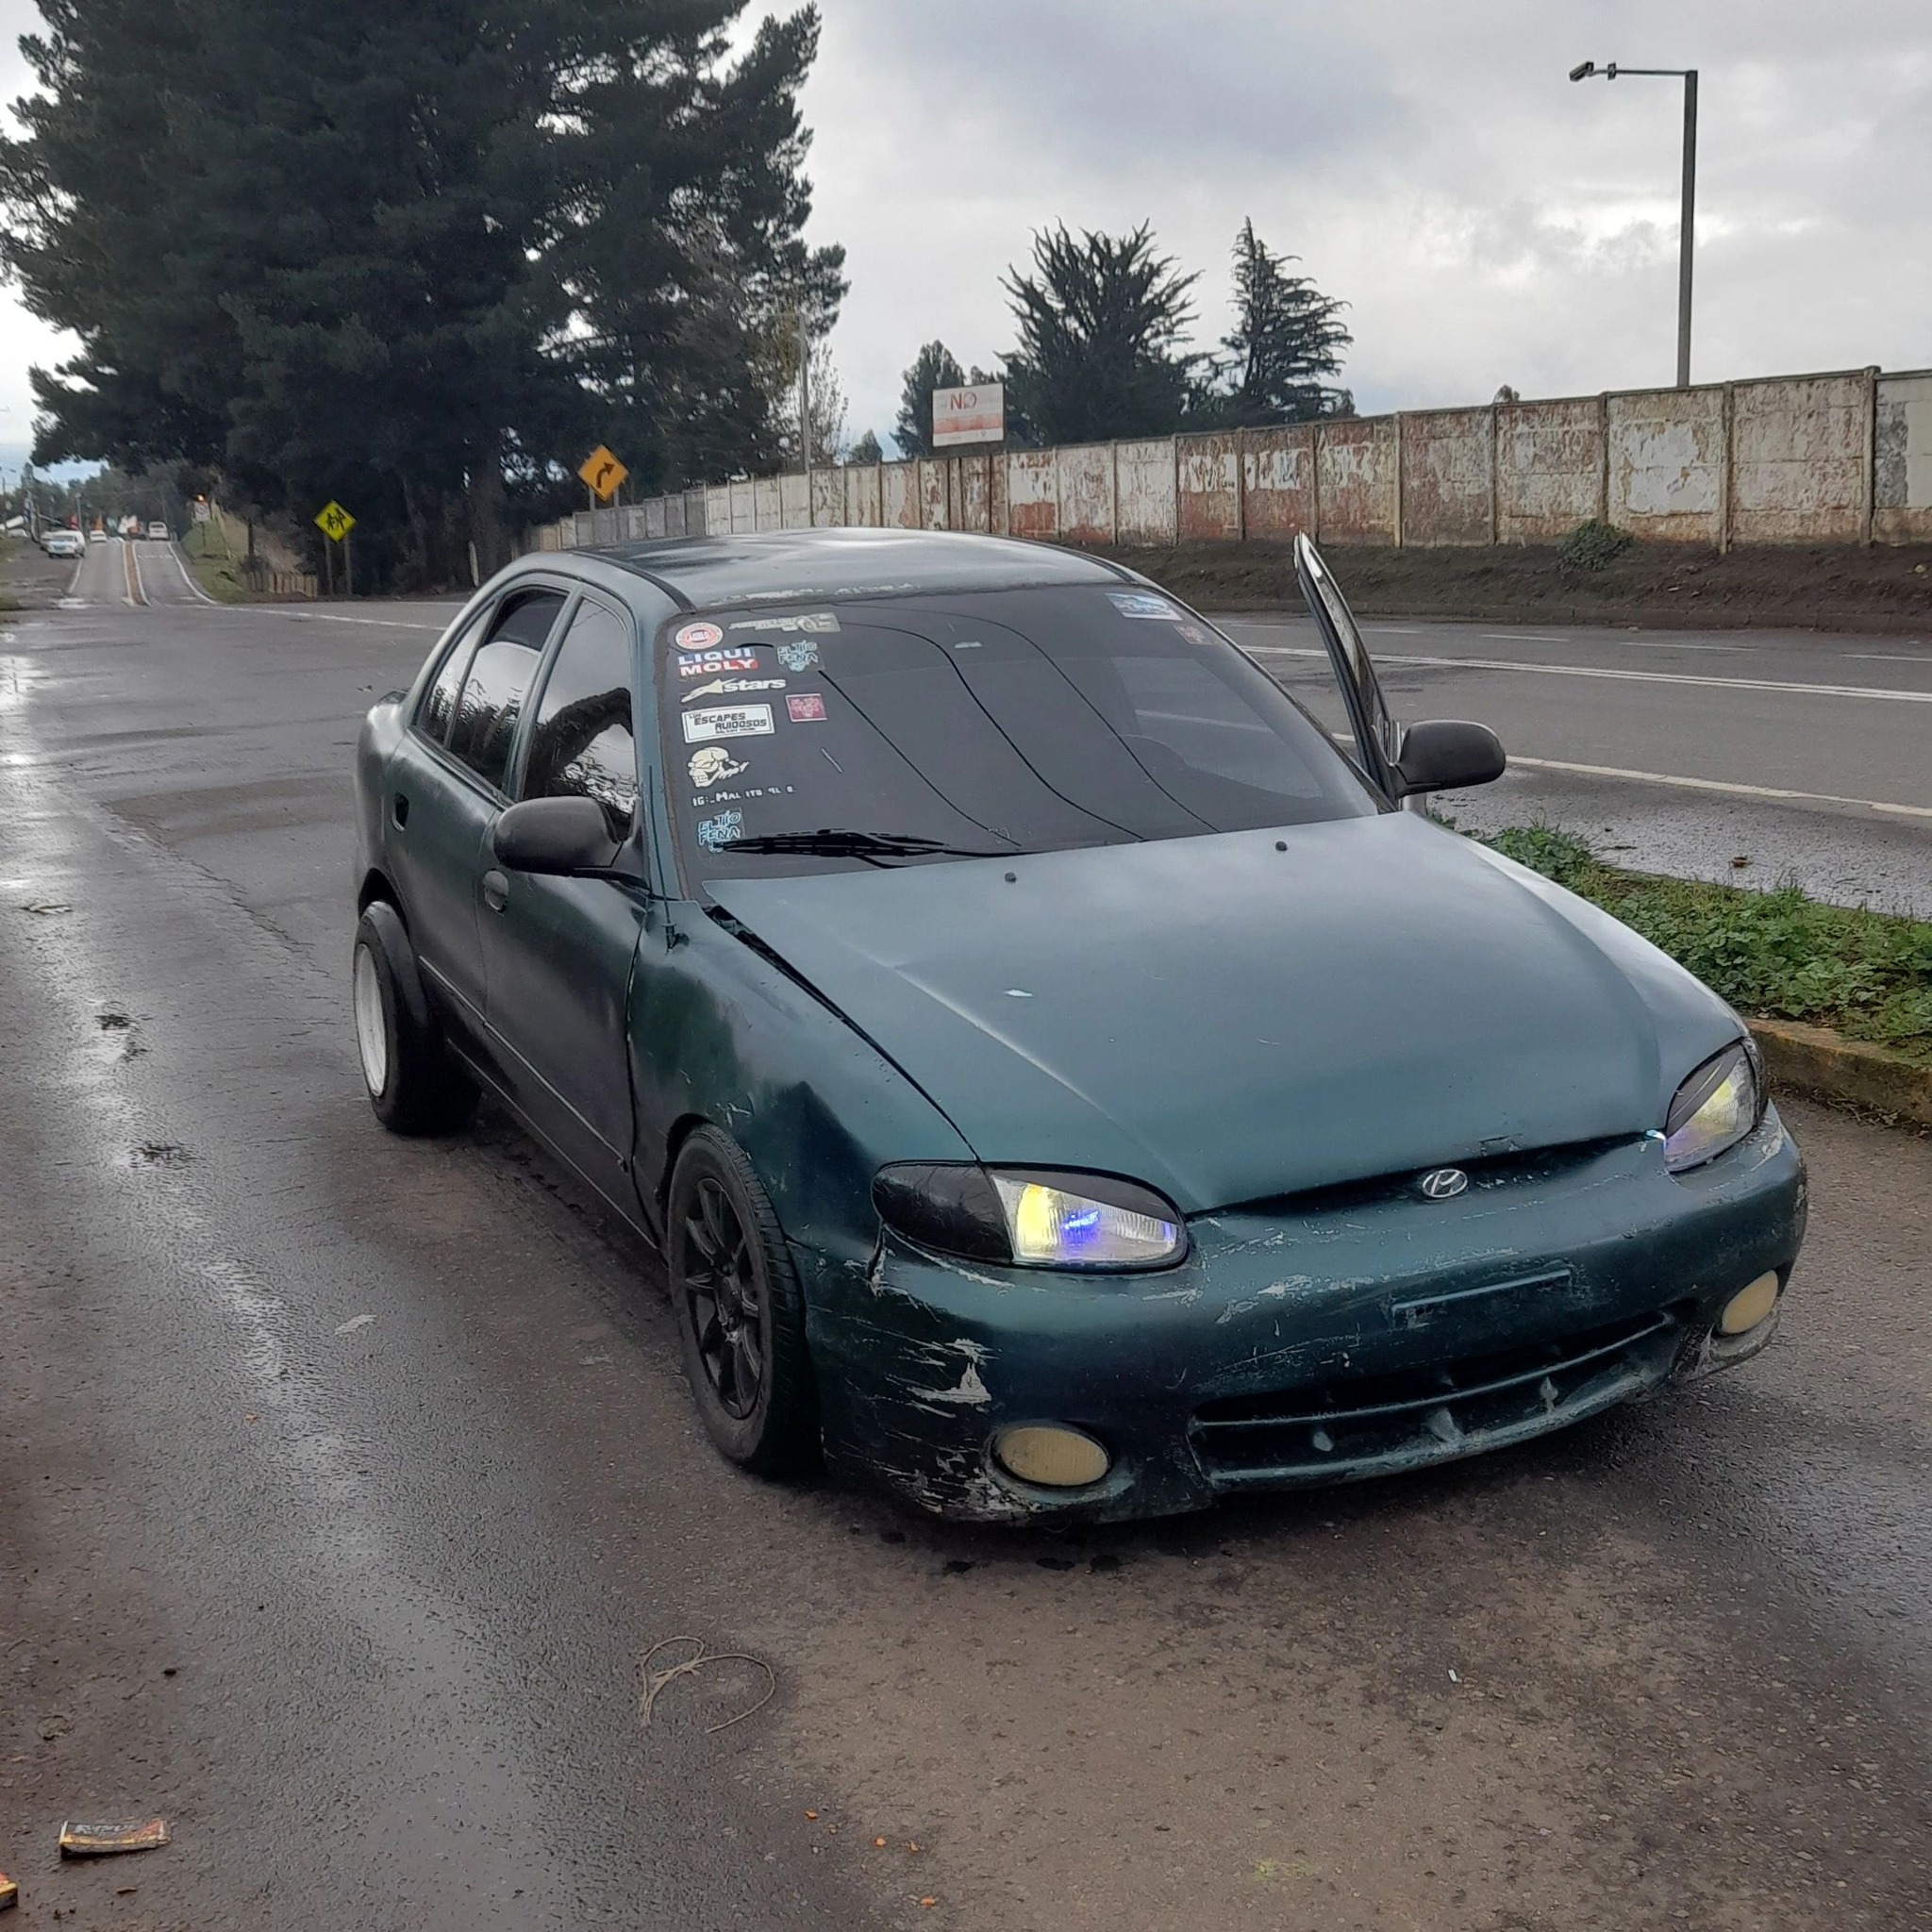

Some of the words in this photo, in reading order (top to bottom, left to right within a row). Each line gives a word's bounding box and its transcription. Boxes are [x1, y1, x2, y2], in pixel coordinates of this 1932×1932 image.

[950, 391, 977, 410] NO
[678, 648, 752, 665] LIQUI
[680, 658, 755, 676] MOLY
[694, 712, 745, 725] ESCAPES
